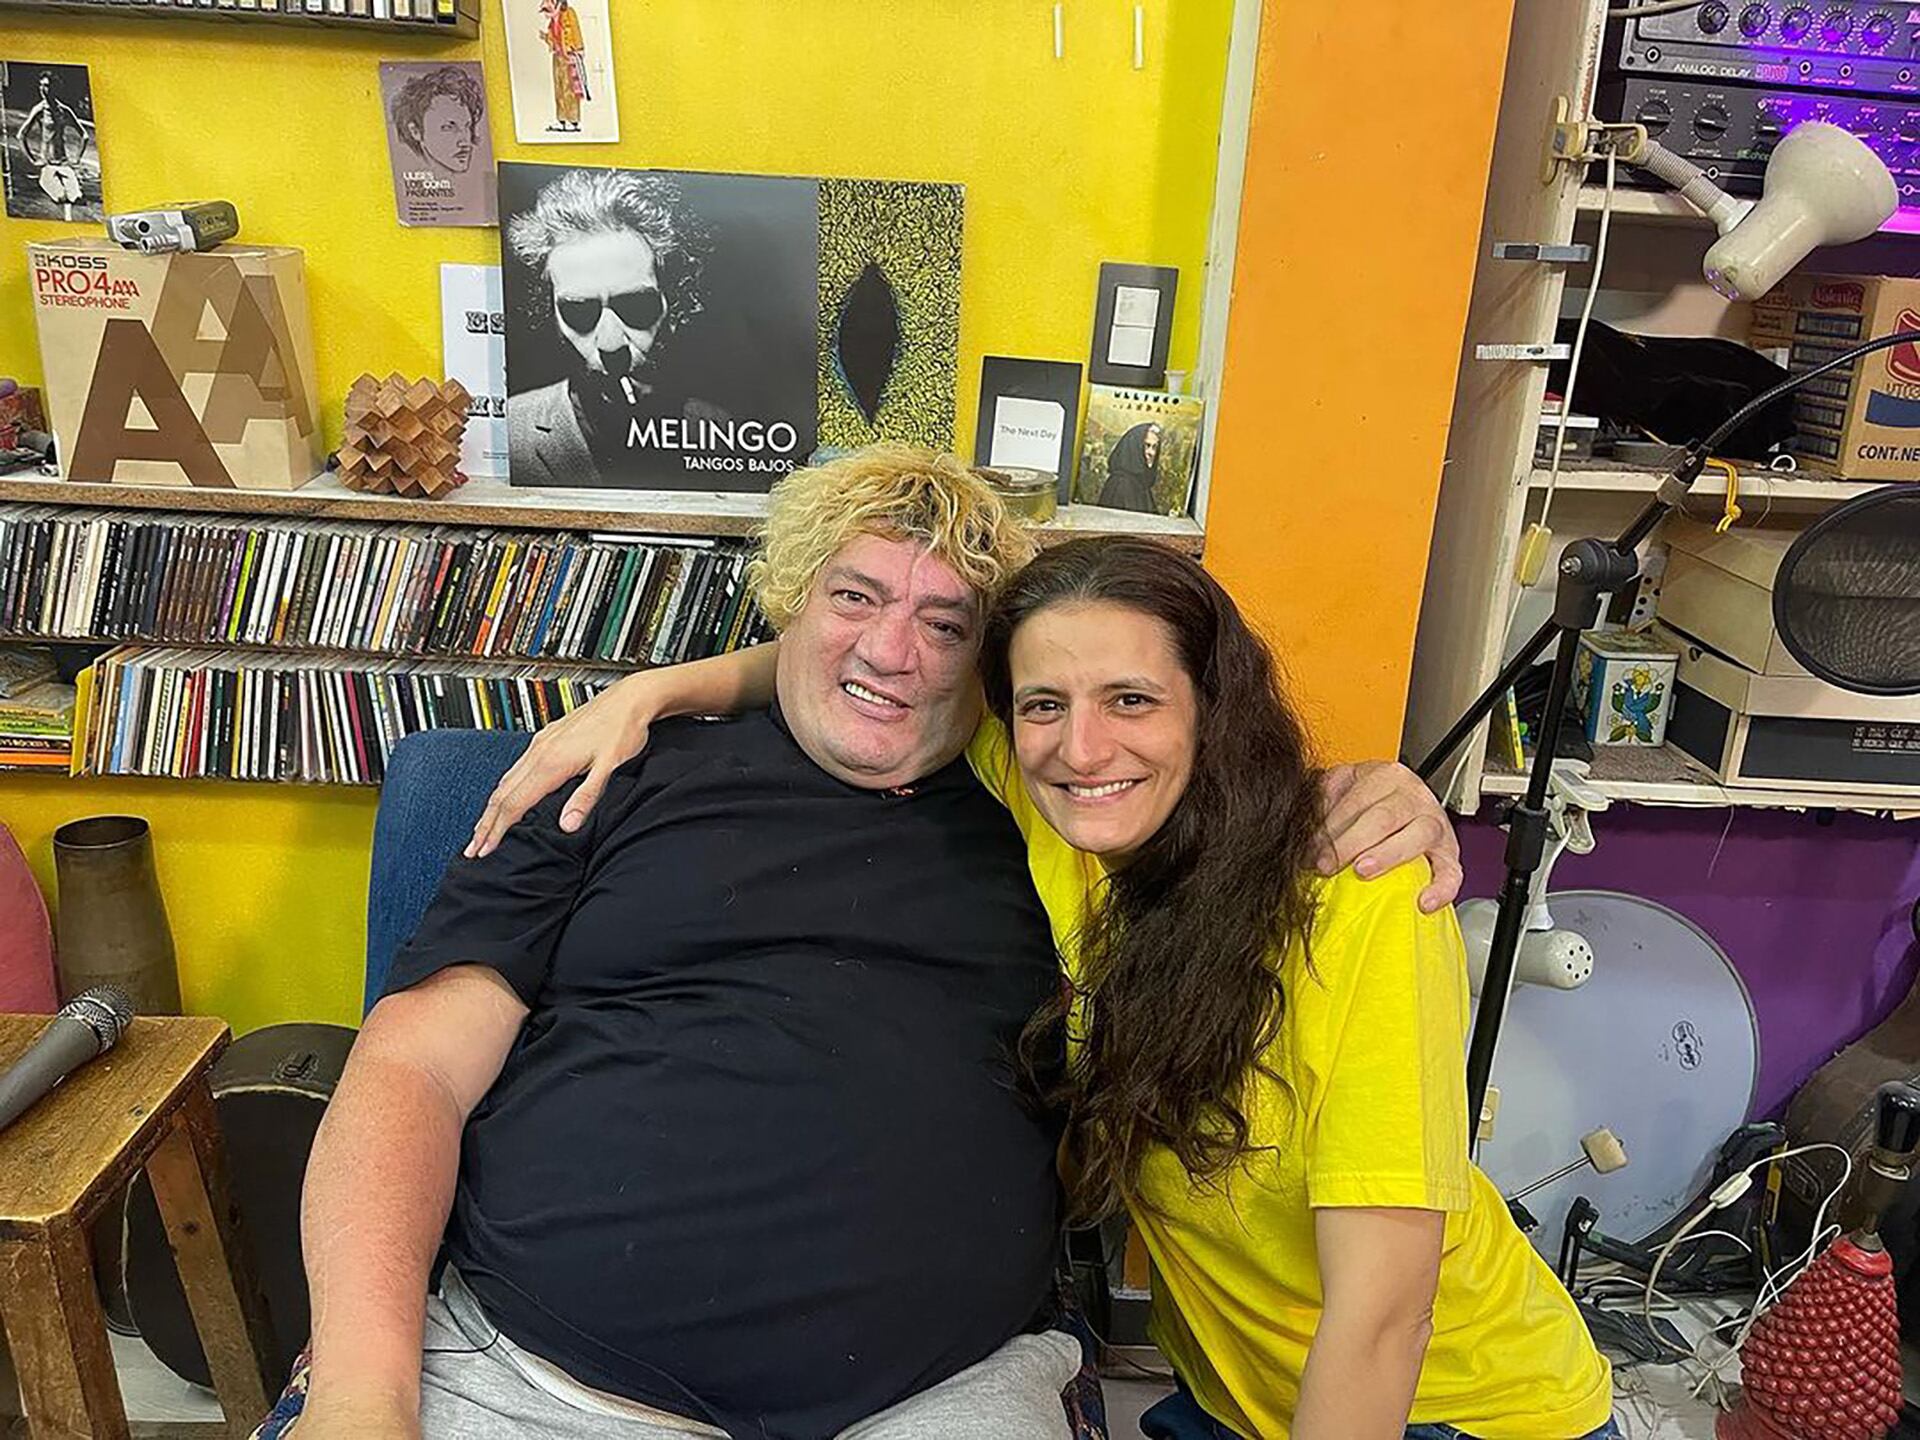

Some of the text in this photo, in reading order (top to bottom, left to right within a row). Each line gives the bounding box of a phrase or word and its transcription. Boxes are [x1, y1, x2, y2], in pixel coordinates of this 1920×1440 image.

[1673, 63, 1716, 76] ANALOG
[47, 255, 108, 269] KOSS
[40, 294, 131, 310] STEREOPHONE
[626, 416, 798, 453] MELINGO
[1001, 424, 1057, 441] The Next Day
[683, 456, 795, 473] TANGOS BAJOS
